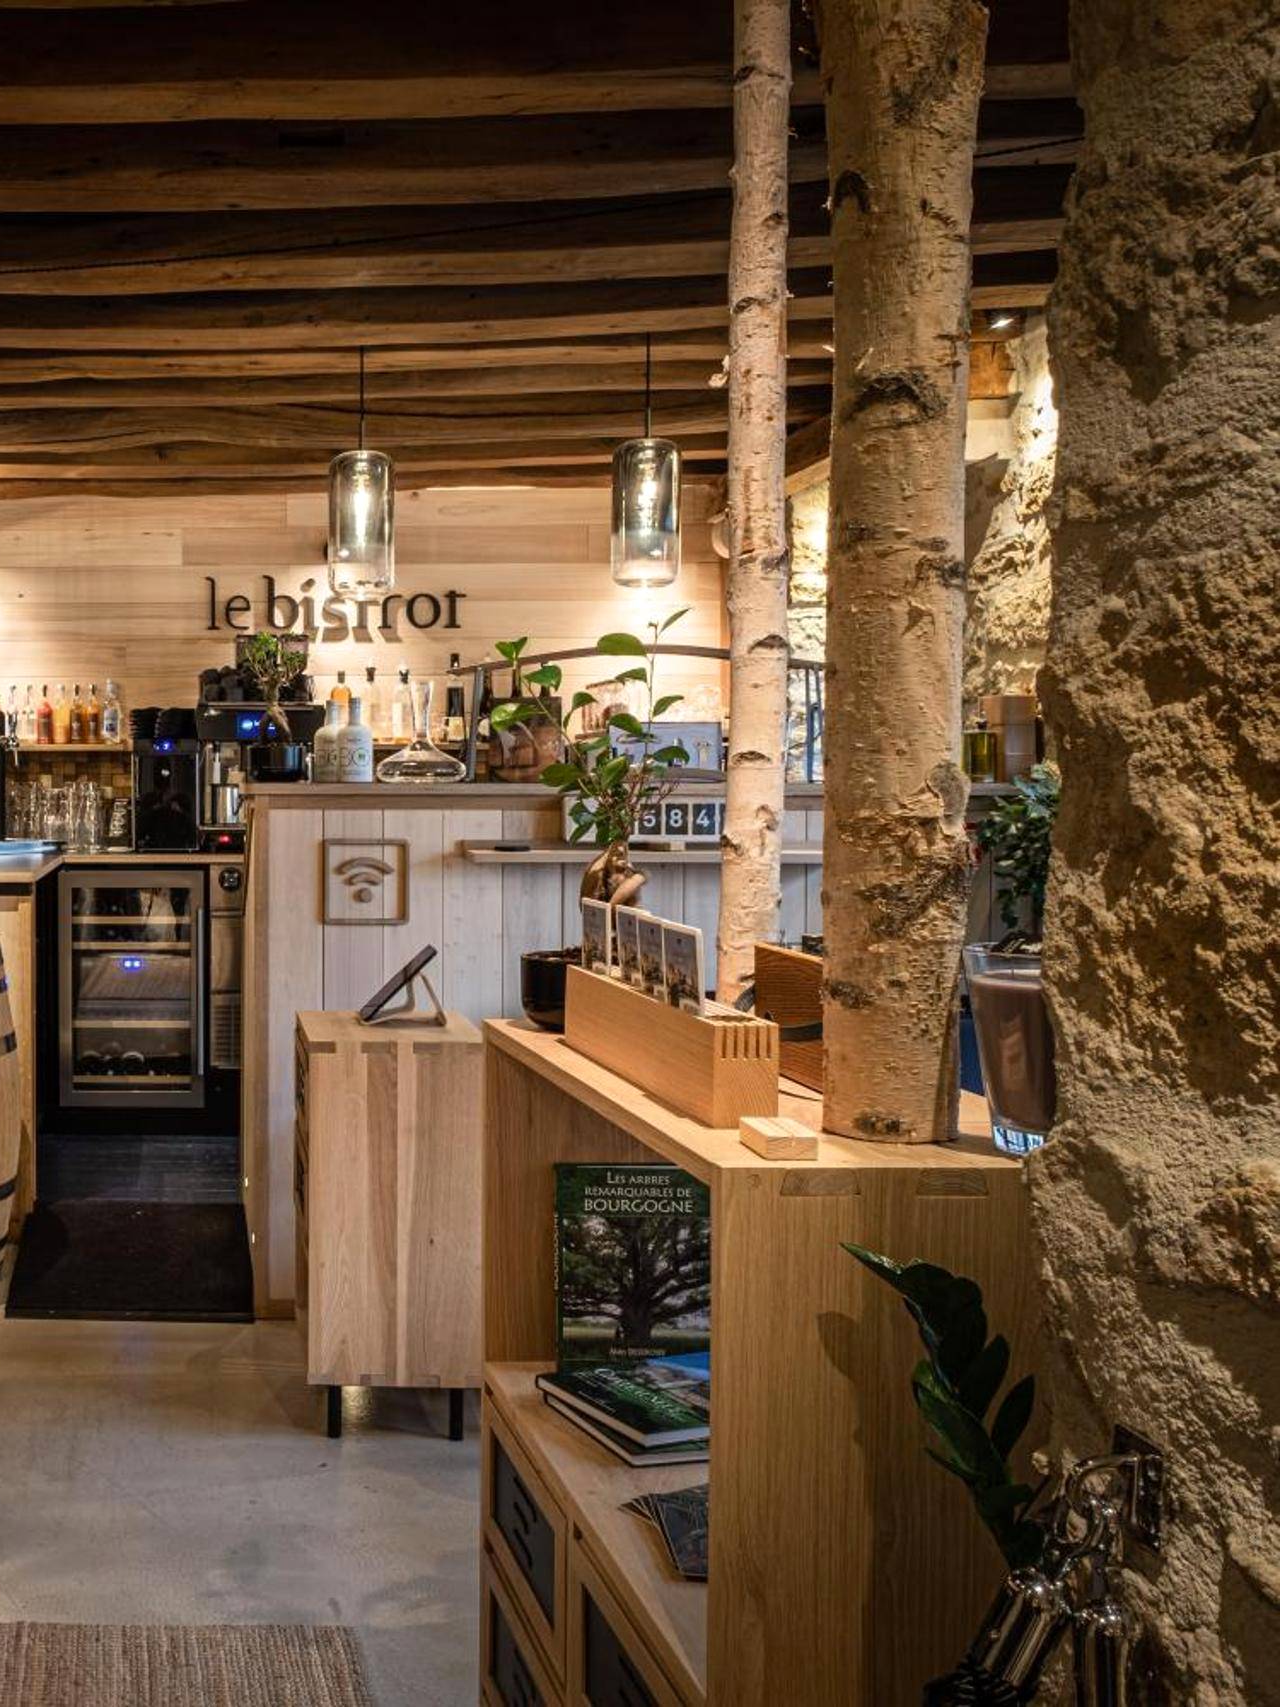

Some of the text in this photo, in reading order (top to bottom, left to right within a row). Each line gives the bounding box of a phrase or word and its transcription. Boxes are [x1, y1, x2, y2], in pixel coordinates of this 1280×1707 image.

[205, 575, 467, 630] le bistrot
[629, 1175, 671, 1185] ARBRES
[584, 1186, 693, 1198] REMARQUABLES DE
[584, 1198, 694, 1214] BOURGOGNE
